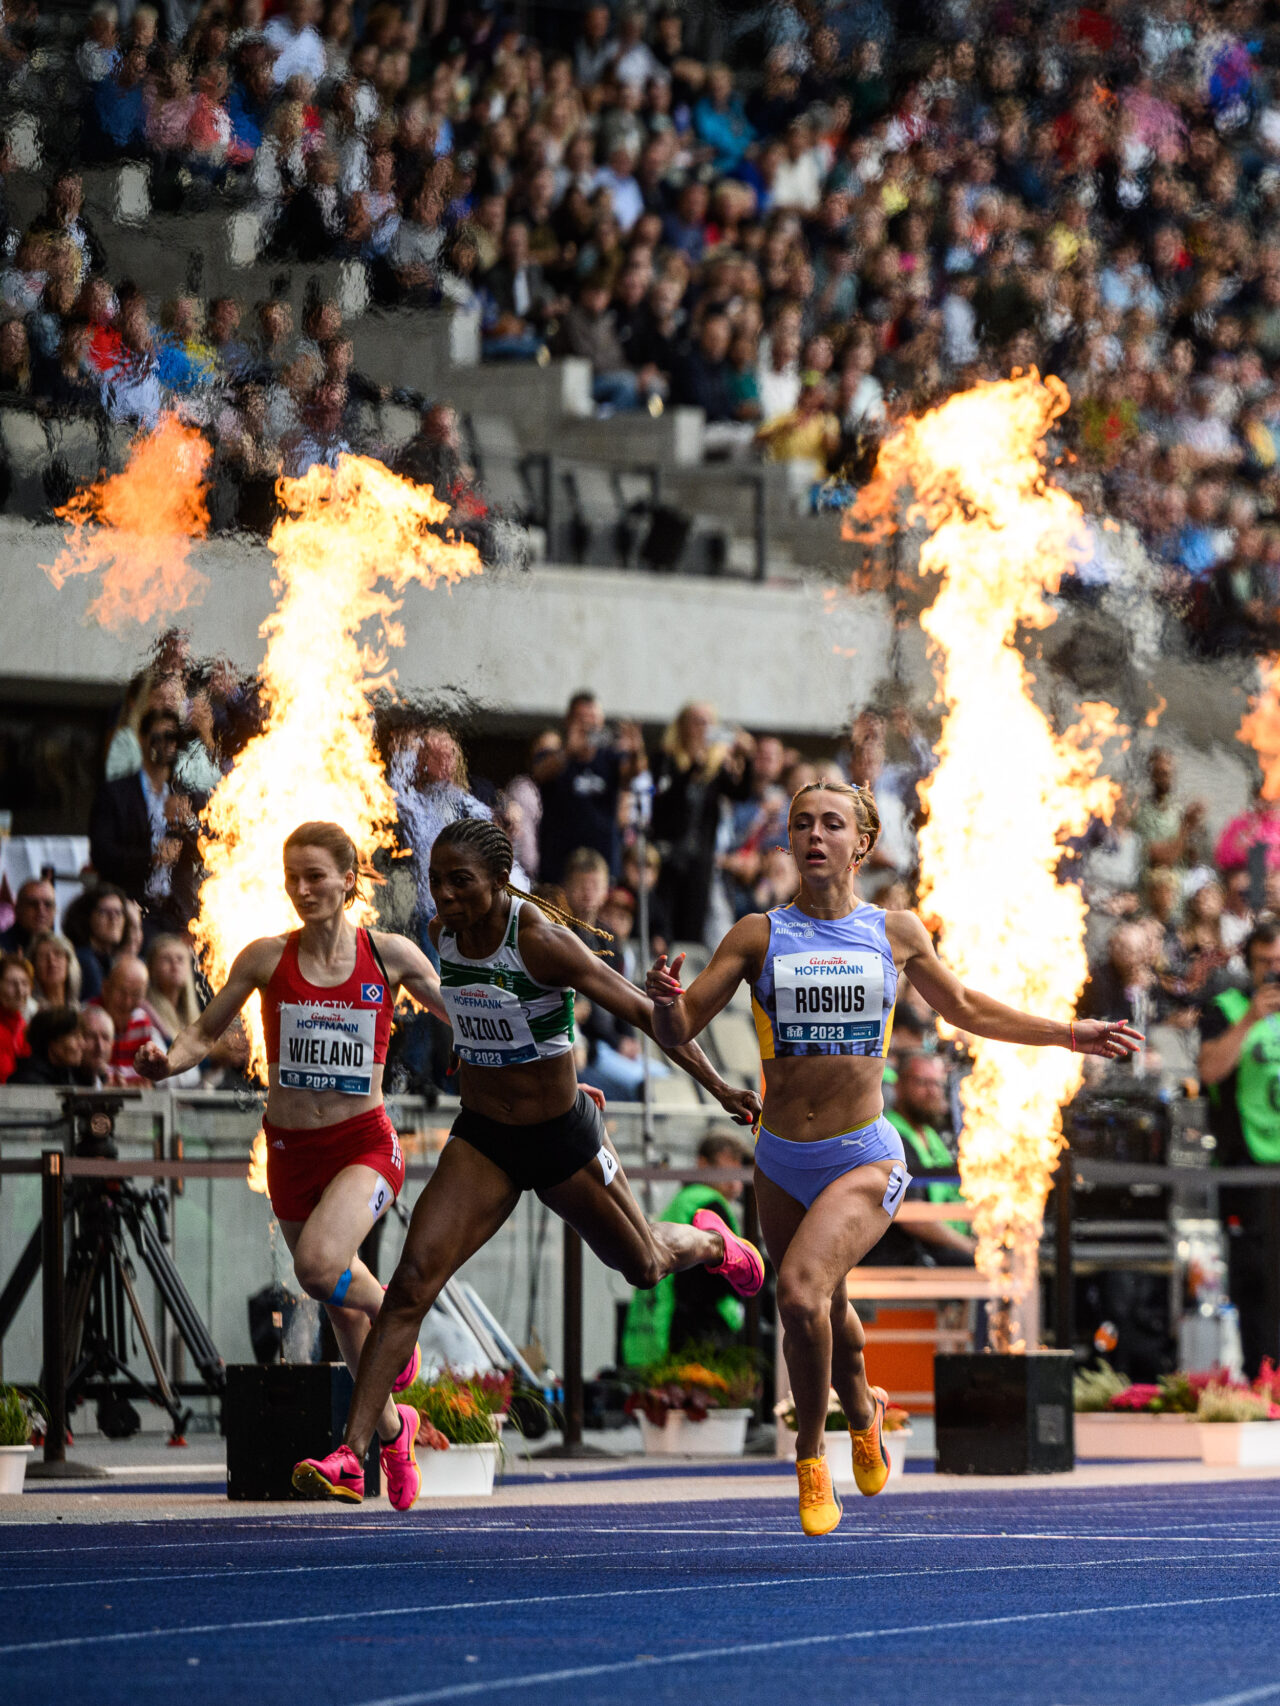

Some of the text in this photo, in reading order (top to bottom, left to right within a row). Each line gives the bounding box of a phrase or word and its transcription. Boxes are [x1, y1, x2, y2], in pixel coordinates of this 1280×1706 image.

[794, 965, 864, 976] HOFFMANN
[453, 995, 503, 1009] HOFFMANN
[795, 985, 865, 1014] ROSIUS
[296, 1019, 359, 1033] HOFFMANN
[456, 1013, 514, 1042] BAZOLO
[810, 1025, 845, 1039] 2023
[288, 1037, 364, 1068] WIELAND
[474, 1051, 503, 1065] 2023
[889, 1176, 903, 1202] 7
[374, 1190, 385, 1211] 9
